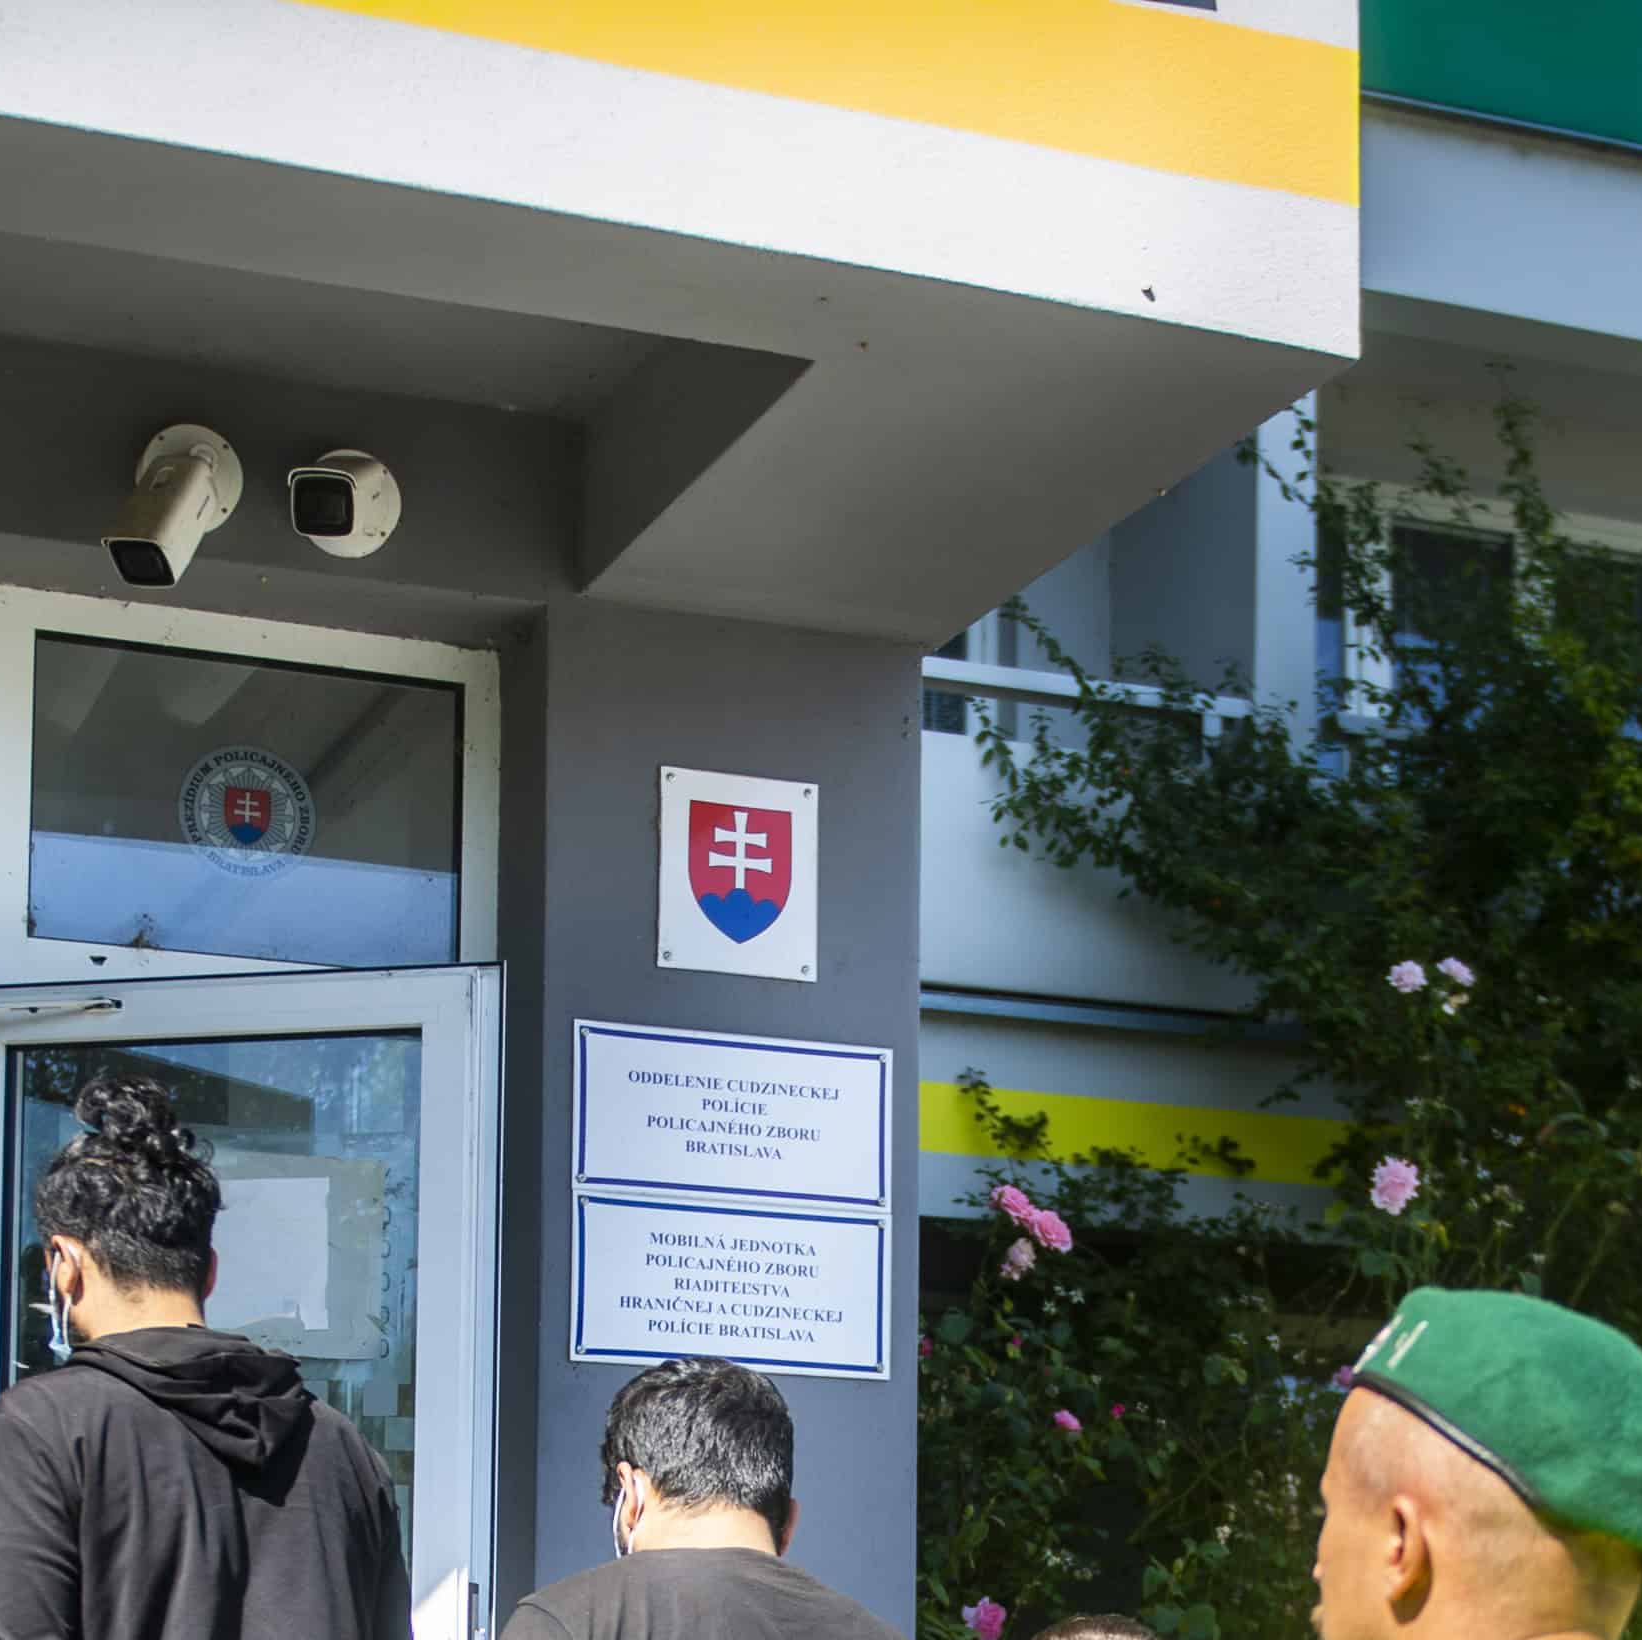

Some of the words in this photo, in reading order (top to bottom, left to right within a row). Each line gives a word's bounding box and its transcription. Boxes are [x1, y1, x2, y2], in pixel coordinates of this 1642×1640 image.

[627, 1070, 725, 1091] ODDELENIE
[726, 1079, 841, 1101] CUDZINECKEJ
[701, 1097, 769, 1116] POLÍCIE
[646, 1115, 762, 1137] POLICAJNÉHO
[765, 1126, 822, 1142] ZBORU
[685, 1140, 783, 1161] BRATISLAVA
[649, 1232, 726, 1251] MOBILNÁ
[729, 1239, 817, 1257] JEDNOTKA
[645, 1253, 762, 1275] POLICAJNÉHO
[764, 1264, 820, 1279] ZBORU
[619, 1295, 713, 1315] HRANIČNEJ
[716, 1303, 728, 1315] A
[730, 1305, 844, 1323] CUDZINECKEJ
[647, 1318, 714, 1336] POLÍCIE
[718, 1326, 816, 1344] BRATISLAVA
